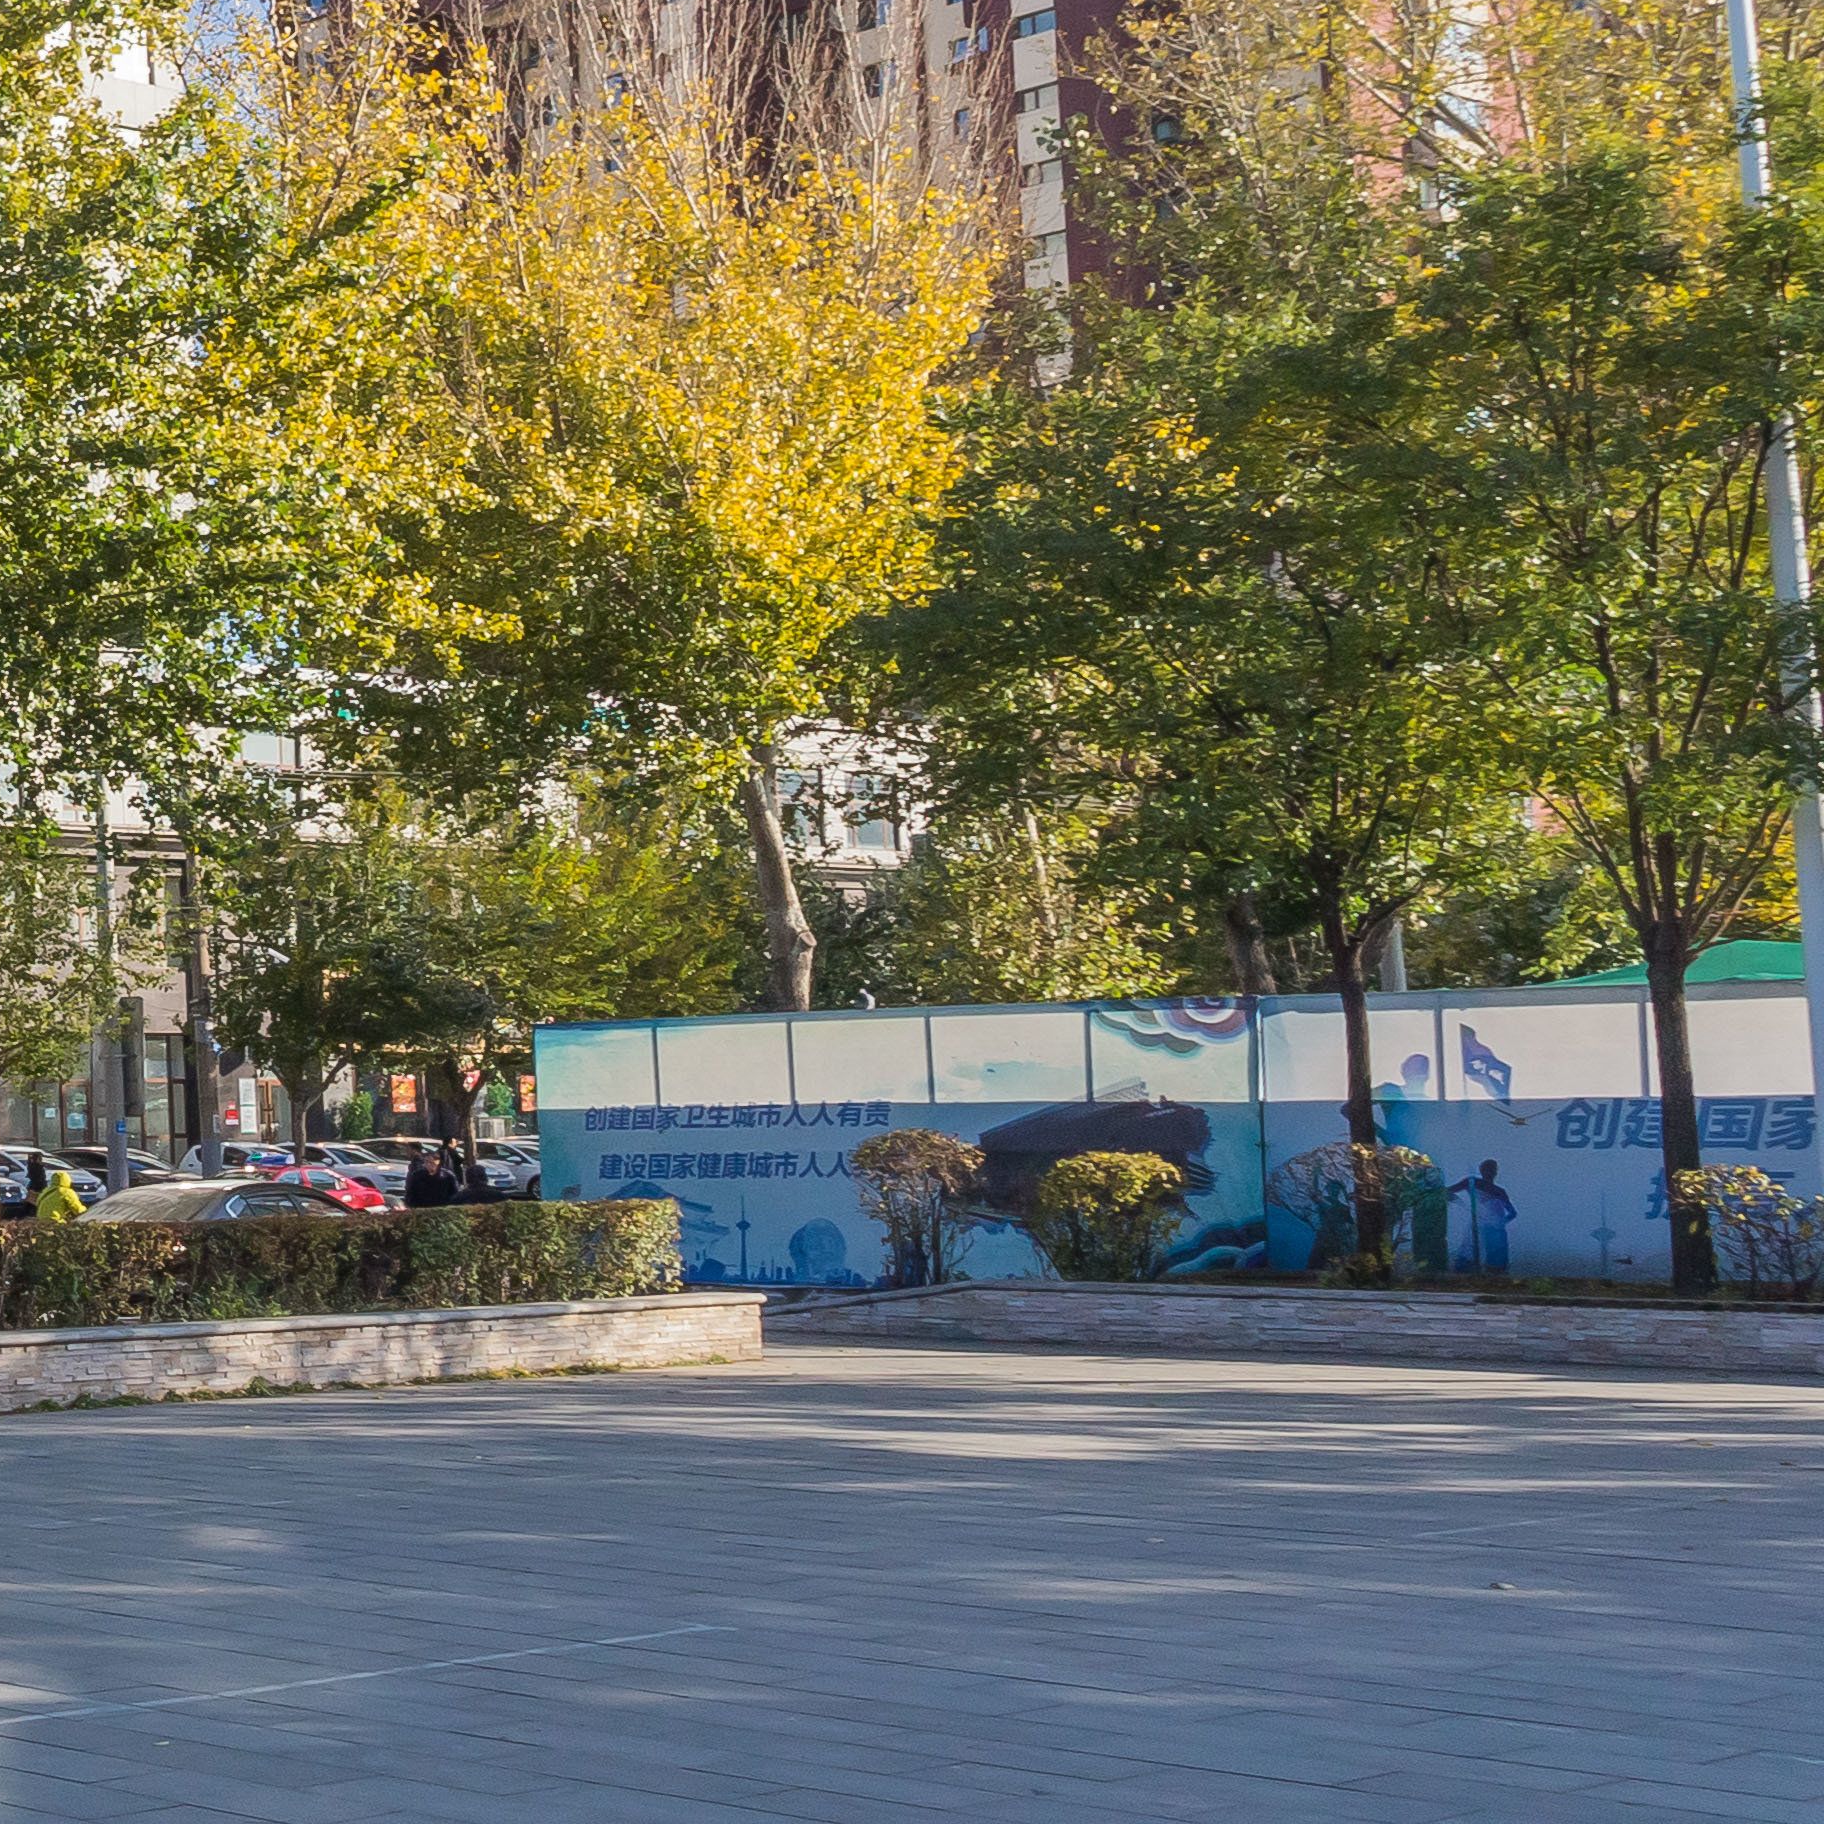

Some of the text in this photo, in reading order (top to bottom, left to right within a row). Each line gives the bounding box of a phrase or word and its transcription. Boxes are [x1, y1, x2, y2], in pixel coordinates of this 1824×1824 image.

[584, 1099, 892, 1132] 创建国家卫生城市人人有责
[598, 1150, 855, 1181] 建设国家健康城市人人
